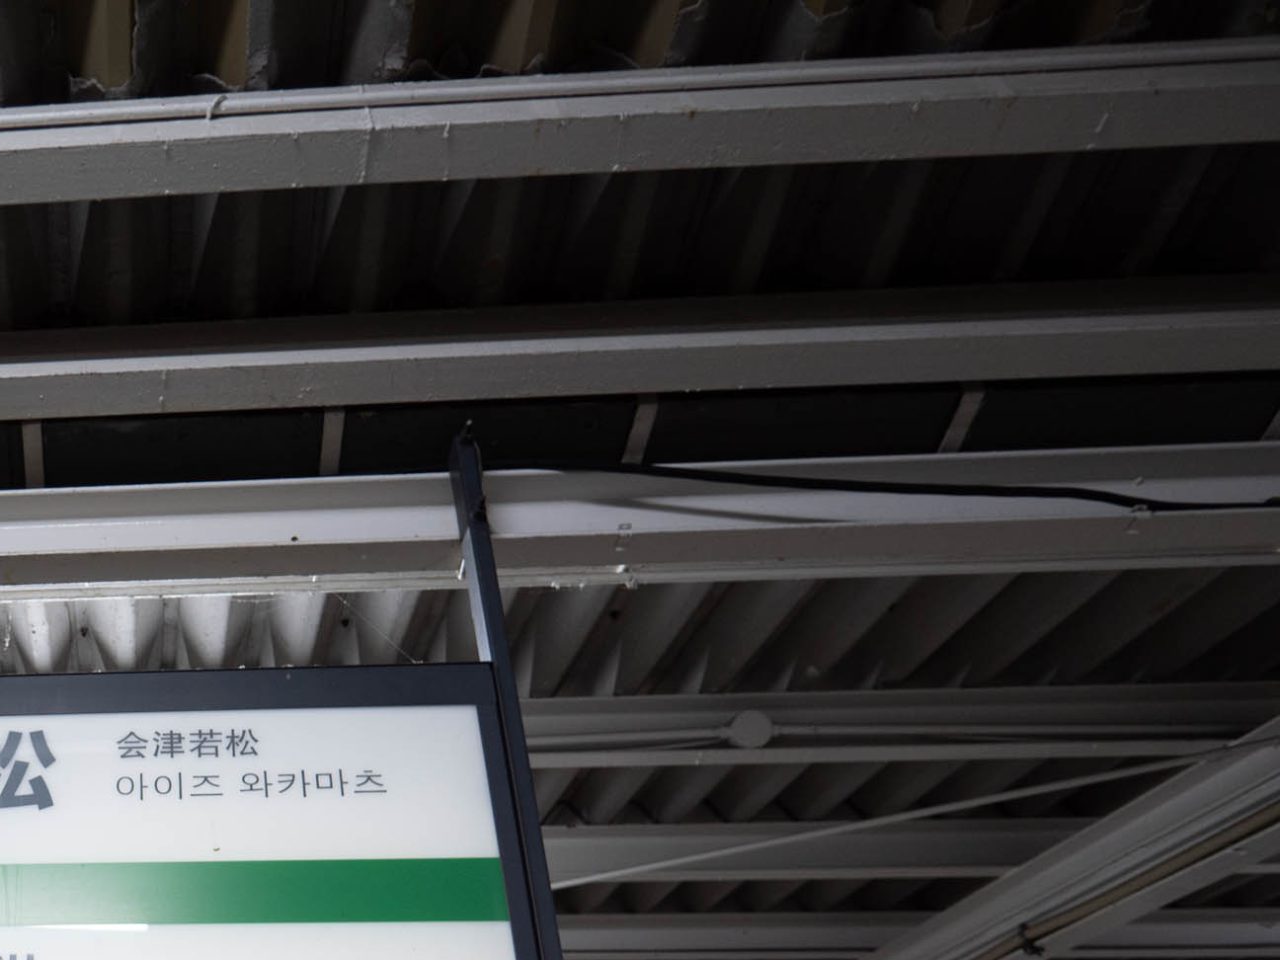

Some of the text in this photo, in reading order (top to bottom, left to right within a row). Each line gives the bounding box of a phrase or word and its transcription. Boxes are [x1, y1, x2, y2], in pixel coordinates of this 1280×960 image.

[116, 728, 259, 759] 会津若松
[116, 768, 388, 800] 아이즈 와카마츠
